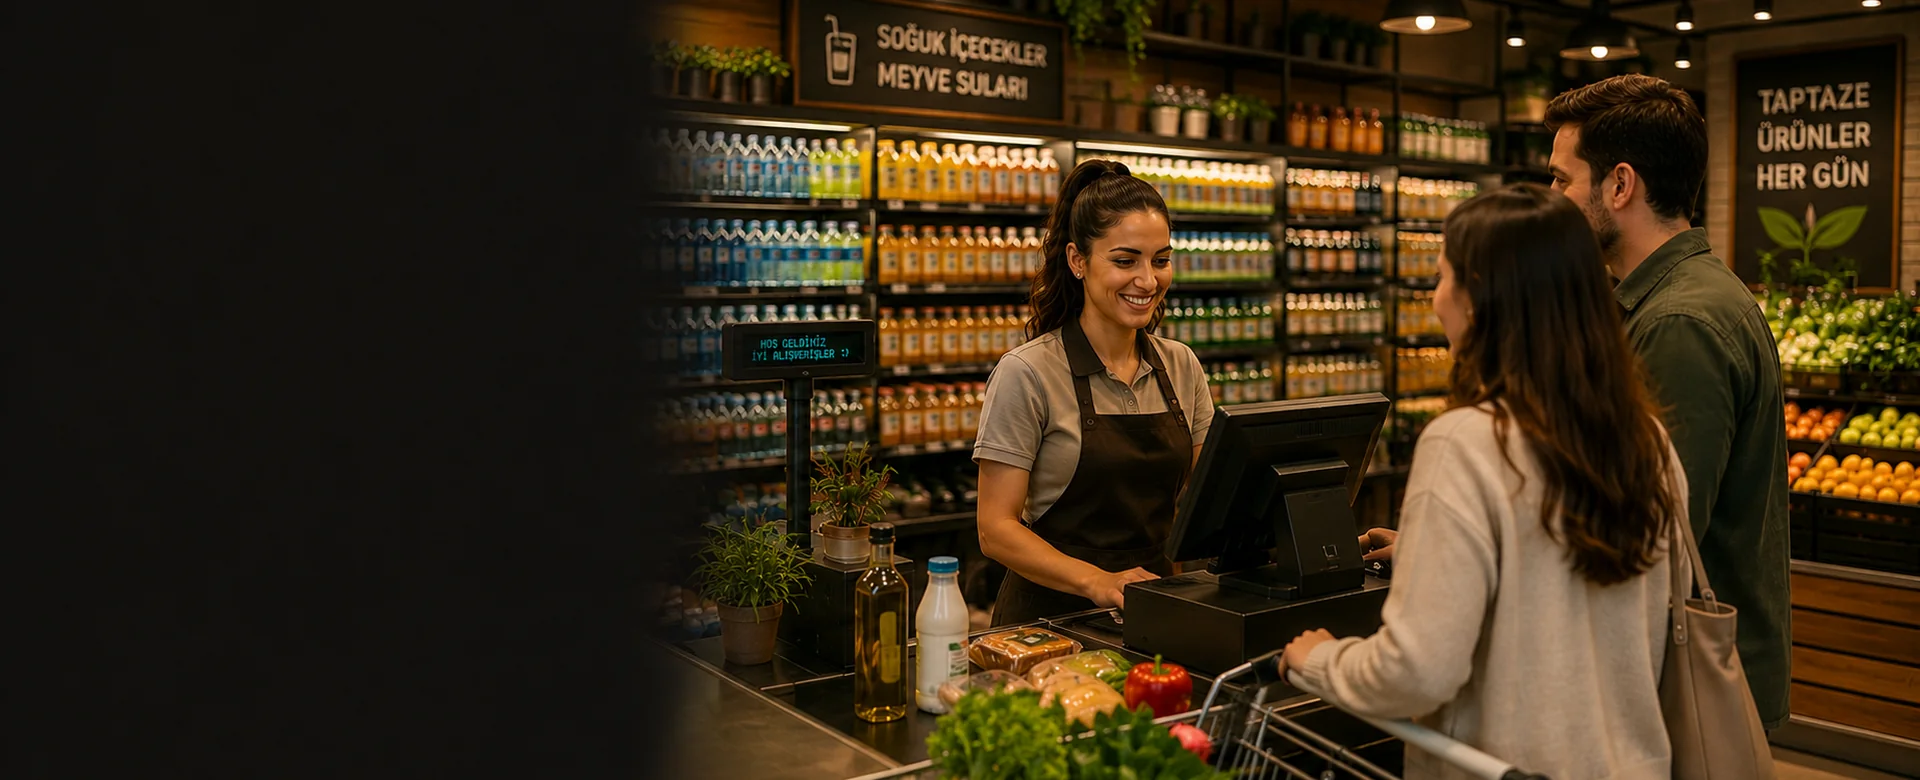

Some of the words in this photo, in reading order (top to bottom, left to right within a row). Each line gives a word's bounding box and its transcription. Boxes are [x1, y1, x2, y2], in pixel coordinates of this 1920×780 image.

[877, 22, 947, 56] SOĞUK
[950, 27, 1048, 68] İÇECEKLER
[877, 61, 951, 93] MEYVE
[955, 69, 1029, 101] SULARI
[1757, 81, 1871, 115] TAPTAZE
[1757, 118, 1872, 153] ÜRÜNLER
[1757, 163, 1807, 191] HER
[1812, 155, 1870, 190] GÜN
